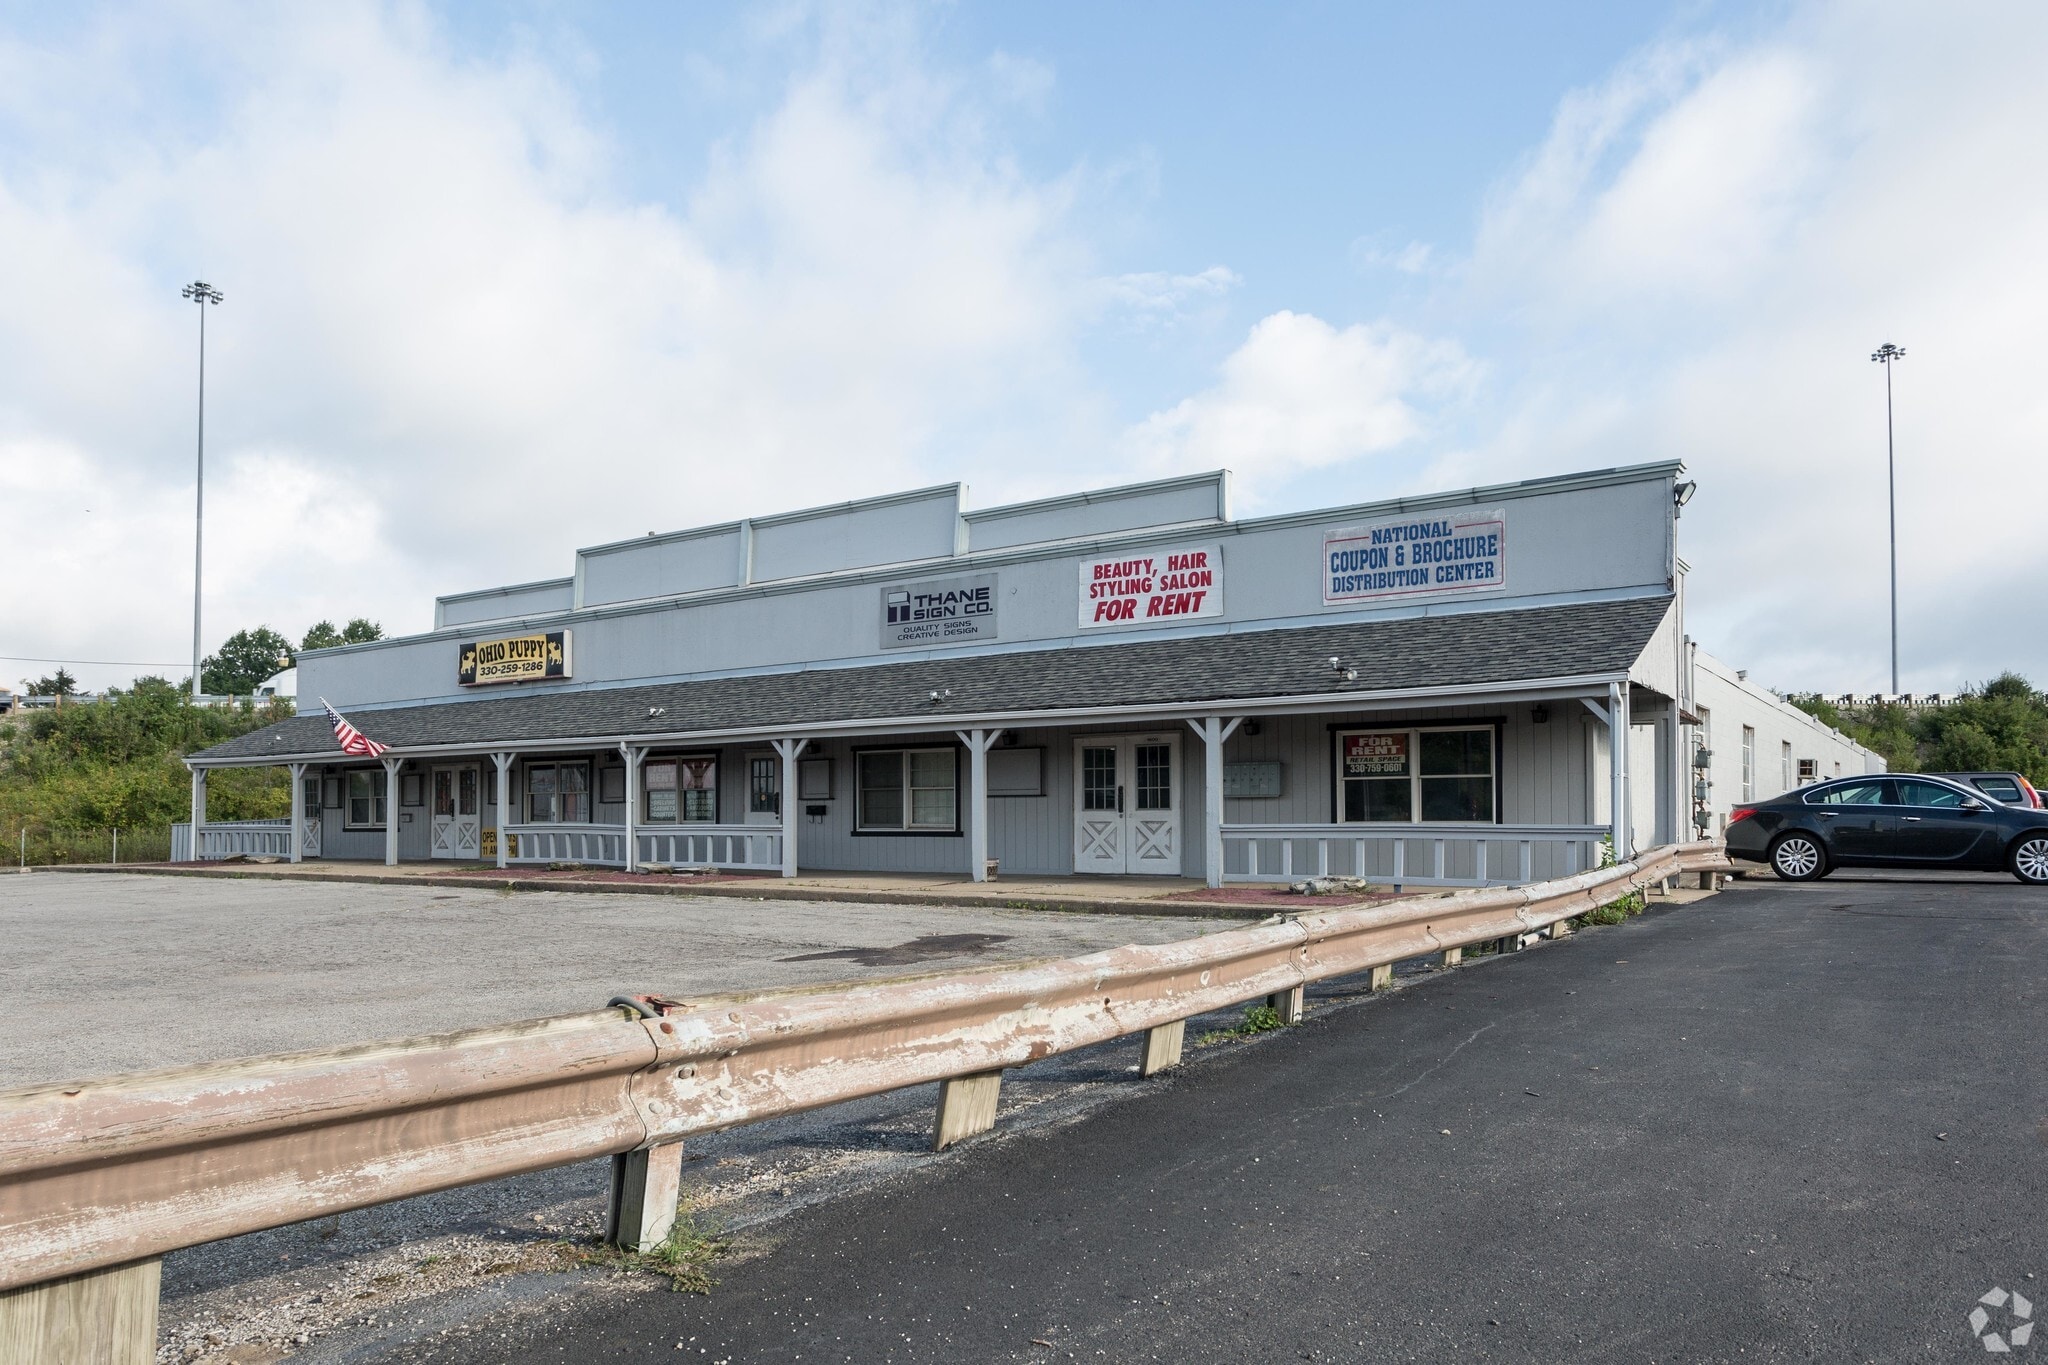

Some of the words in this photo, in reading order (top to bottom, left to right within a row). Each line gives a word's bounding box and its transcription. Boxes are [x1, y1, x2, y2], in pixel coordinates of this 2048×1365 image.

[1371, 521, 1453, 545] NATIONAL
[1331, 547, 1388, 573] COUPON
[1395, 545, 1404, 566] &
[1412, 534, 1498, 565] BROCHURE
[1093, 559, 1158, 580] BEAUTY,
[1168, 552, 1207, 571] HAIR
[1332, 567, 1429, 593] DISTRIBUTION
[1436, 561, 1494, 584] CENTER
[1090, 577, 1152, 599] STYLING
[1160, 570, 1212, 592] SALON
[914, 587, 990, 608] THANE
[1094, 598, 1137, 622] FOR
[1146, 591, 1207, 617] RENT
[913, 605, 956, 620] SIGN
[964, 602, 993, 614] CO.
[897, 631, 940, 640] CREATIVE
[944, 627, 978, 636] DESIGN
[903, 623, 940, 633] QUALITY
[943, 620, 972, 629] SIGNS
[479, 643, 505, 665] OHIO
[509, 640, 545, 658] PUPPY
[480, 661, 544, 676] 330-259-1286
[1351, 745, 1401, 755] RENT
[1359, 736, 1393, 746] FOR
